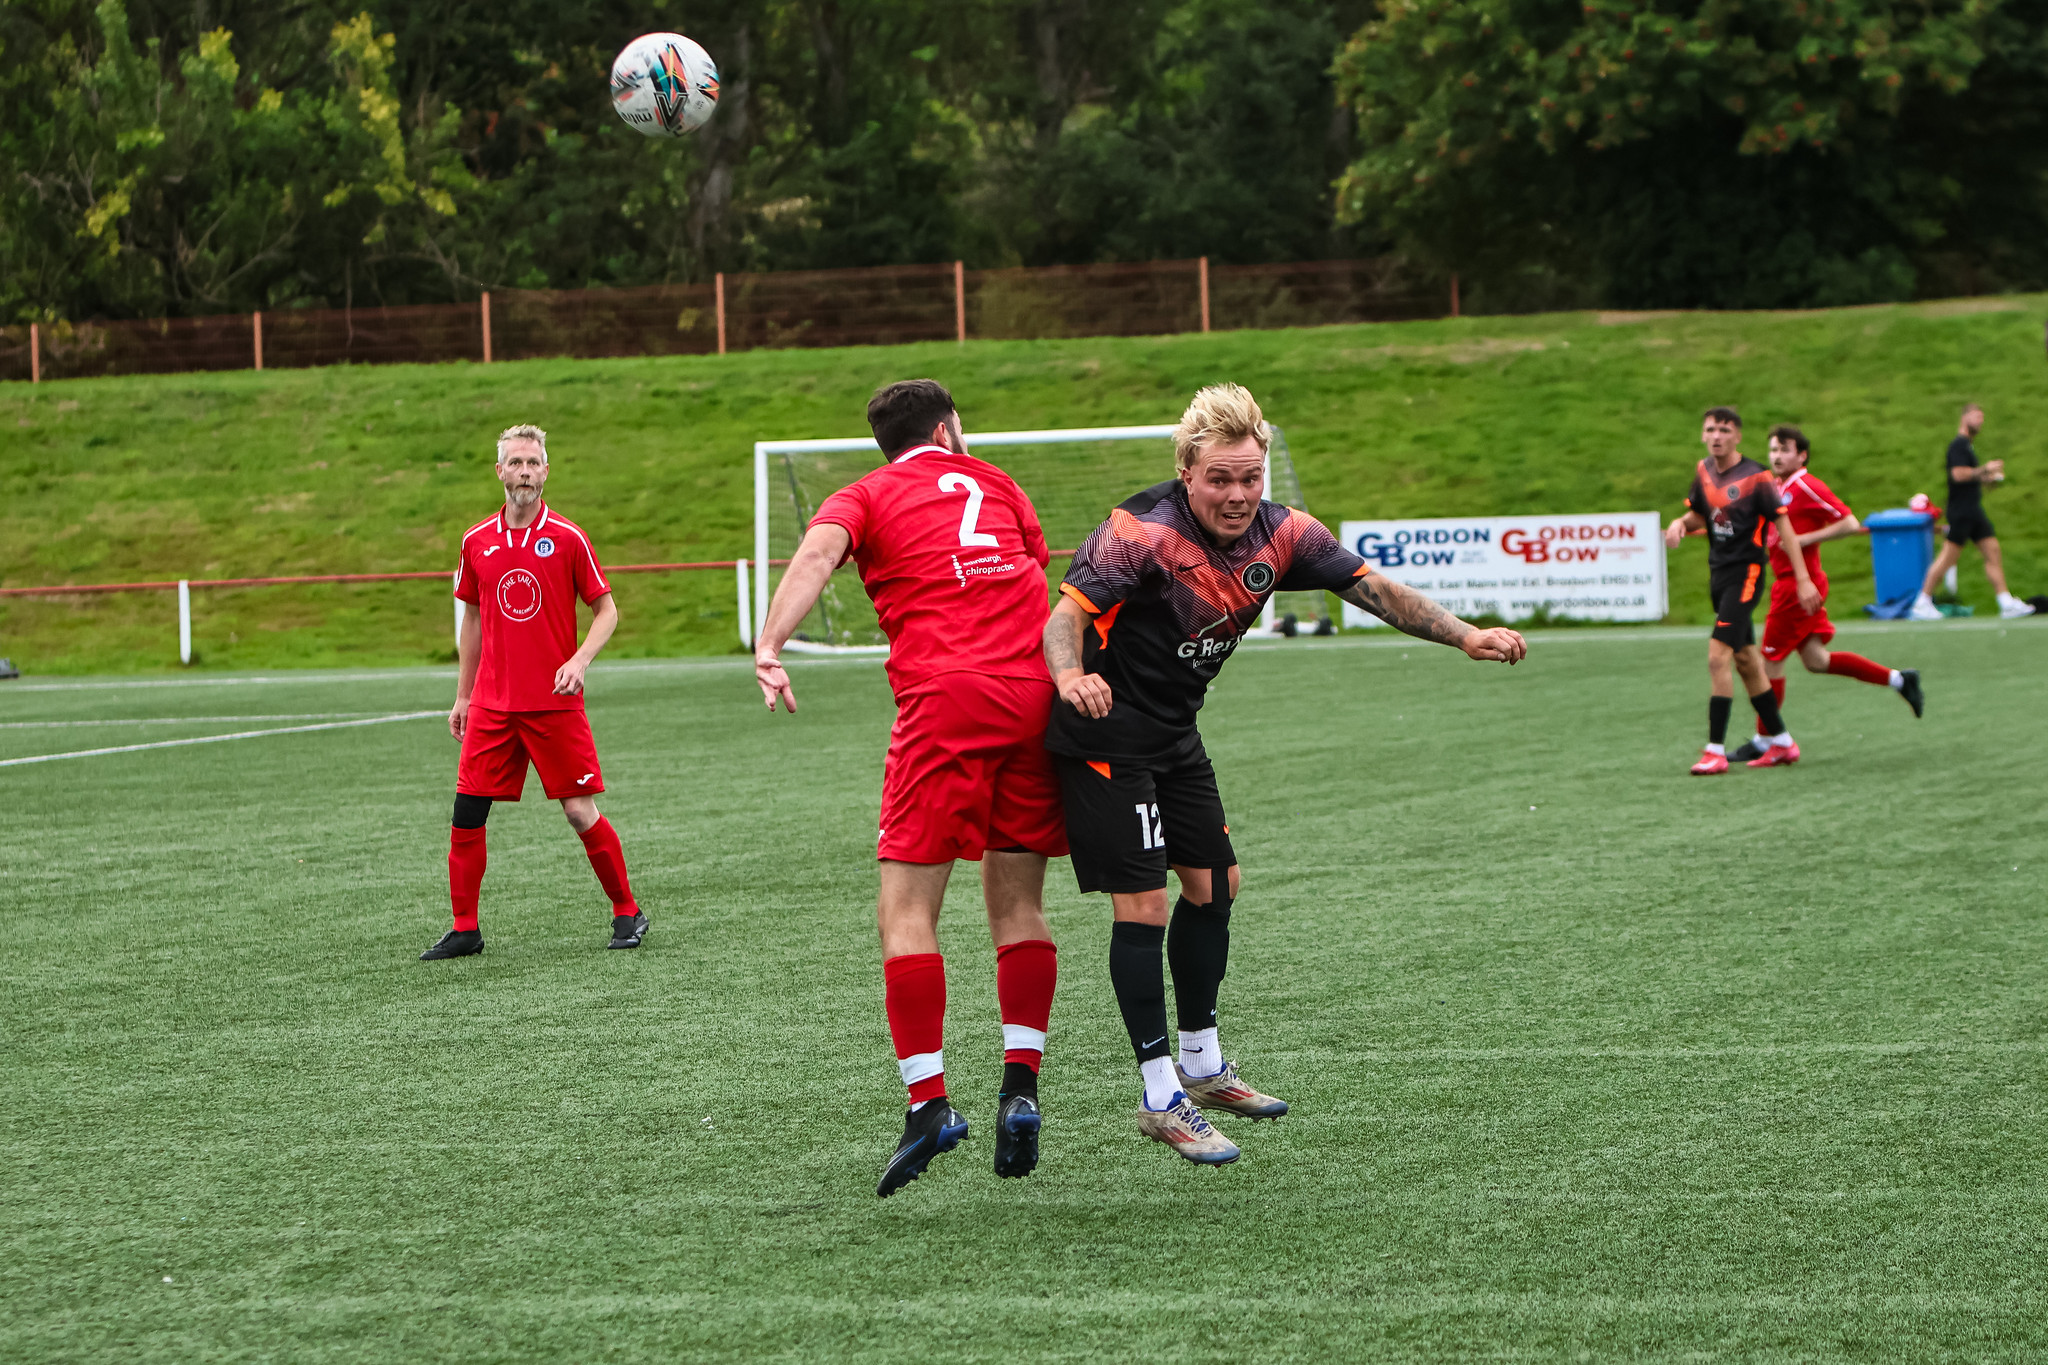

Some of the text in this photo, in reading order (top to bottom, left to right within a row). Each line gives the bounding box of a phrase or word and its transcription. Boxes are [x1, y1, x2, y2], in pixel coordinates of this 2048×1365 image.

[938, 472, 1000, 547] 2
[1357, 528, 1491, 559] GORDON
[1501, 524, 1636, 556] GORDON
[1517, 540, 1600, 563] BOW
[1373, 543, 1455, 567] BOW
[965, 562, 1016, 576] chiropractic
[502, 574, 533, 590] THE EARL
[1177, 641, 1198, 658] G
[1135, 802, 1166, 850] 12
